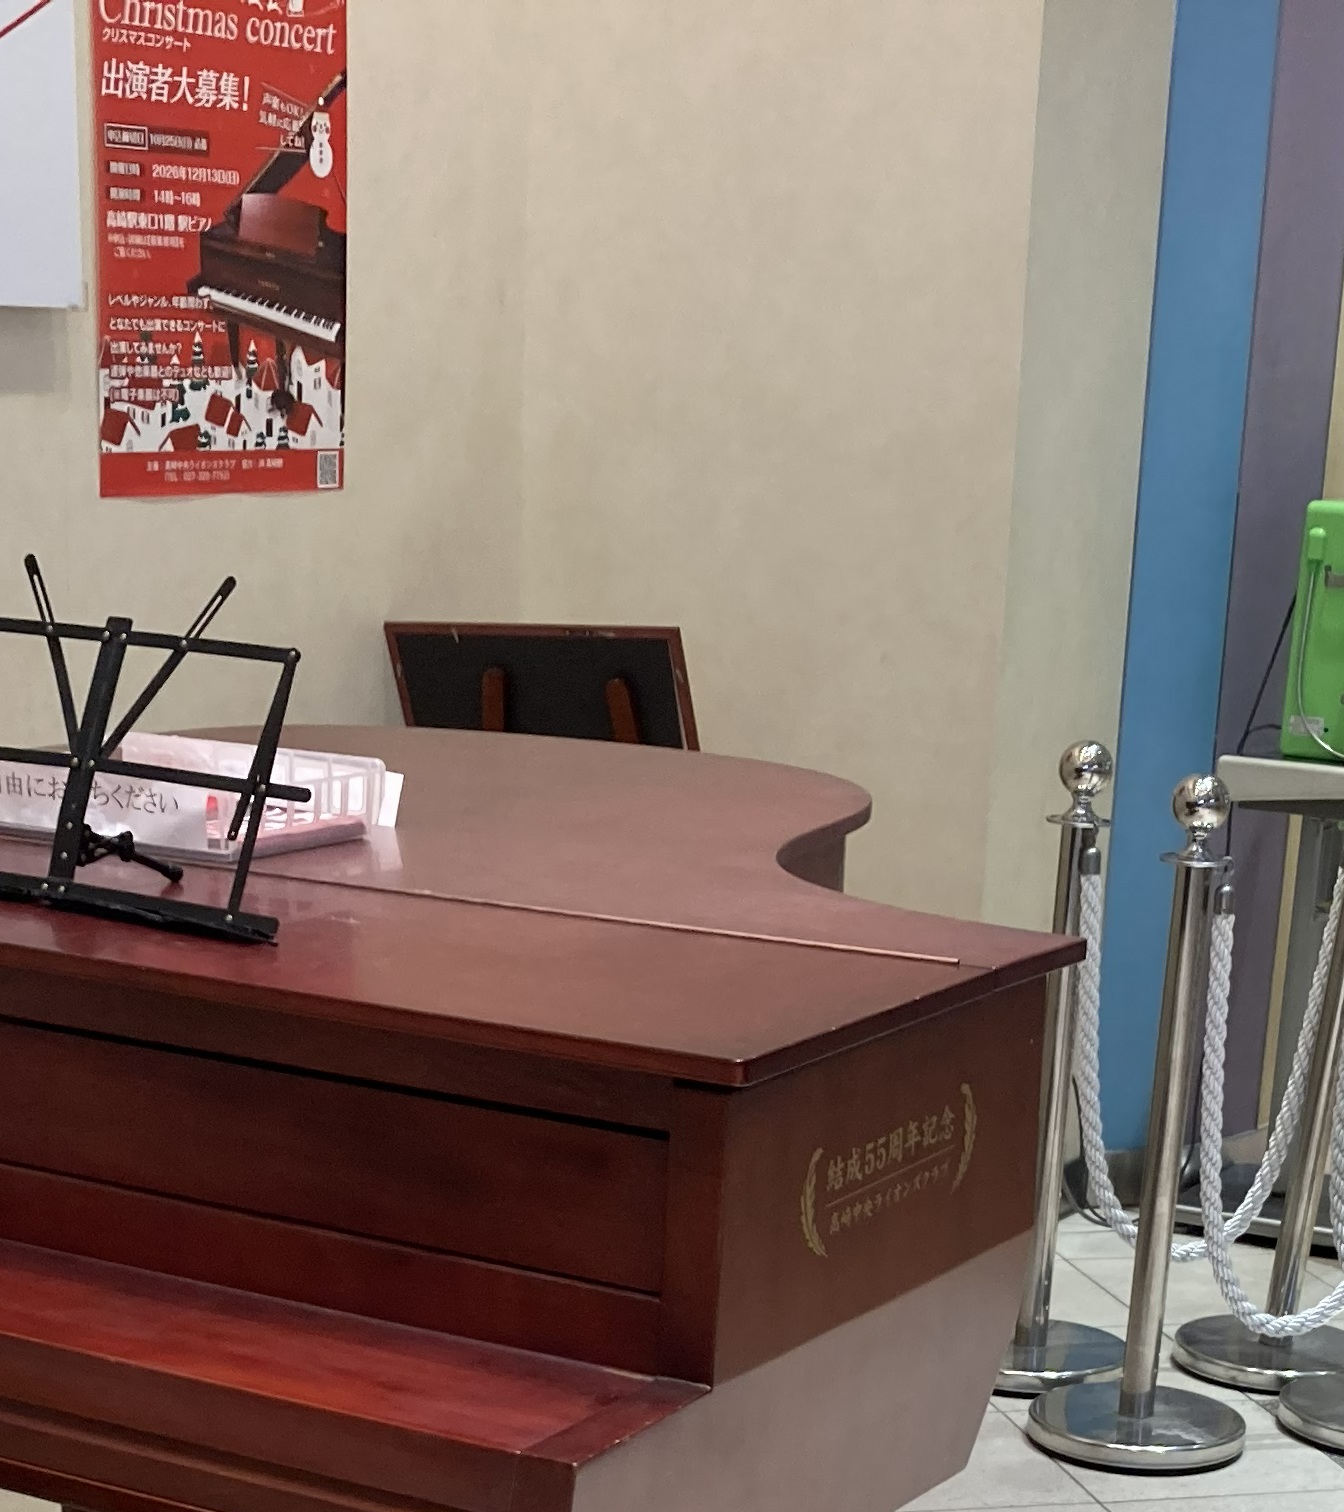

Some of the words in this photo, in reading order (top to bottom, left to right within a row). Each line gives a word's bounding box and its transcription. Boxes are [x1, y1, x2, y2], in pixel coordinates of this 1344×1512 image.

[99, 0, 239, 41] Christmas
[246, 17, 338, 54] concert
[102, 28, 192, 52] クリスマスコンサート
[826, 1105, 956, 1192] 結成55周年記念
